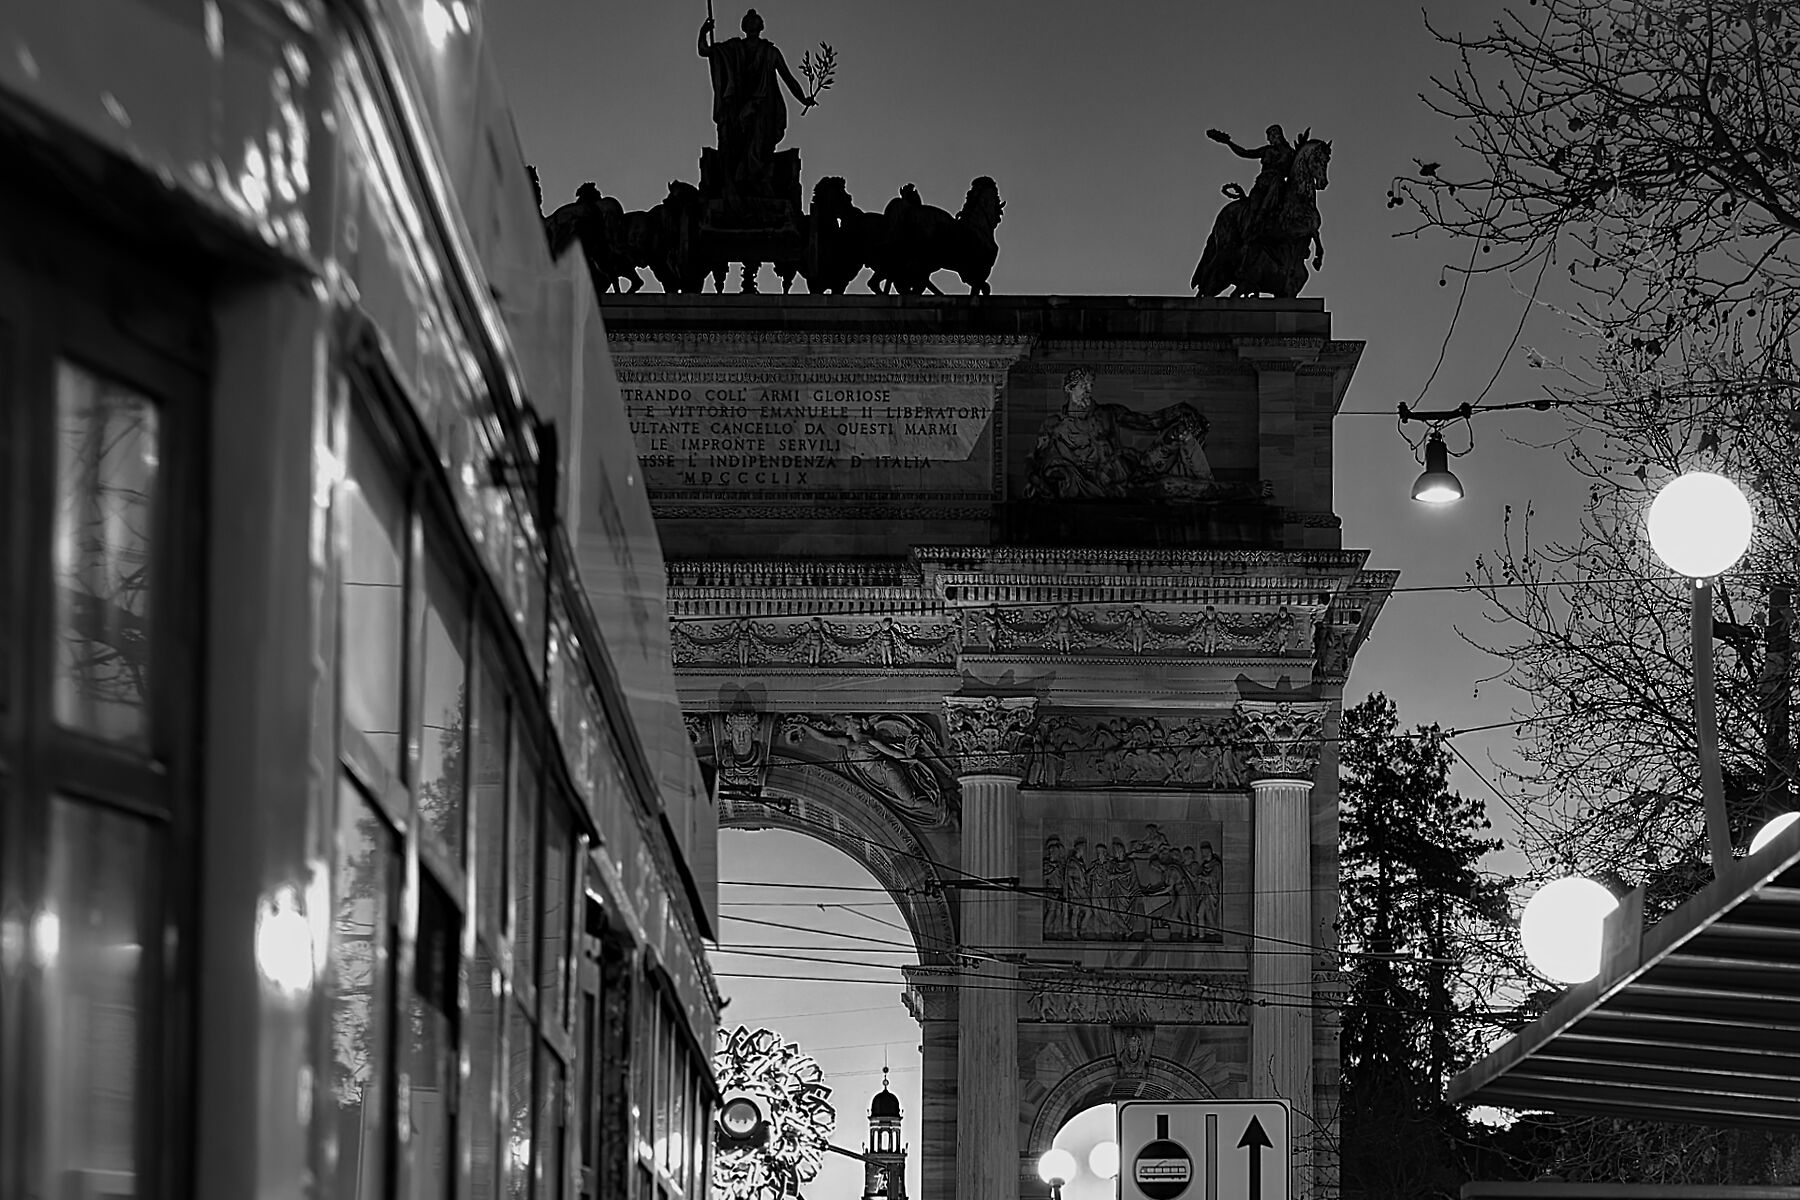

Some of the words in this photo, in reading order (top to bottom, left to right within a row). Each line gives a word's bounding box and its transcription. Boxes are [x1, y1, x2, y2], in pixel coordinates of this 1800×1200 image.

[621, 389, 691, 401] TRANDO
[760, 390, 799, 401] ARMI
[814, 390, 890, 402] GLORIOSE
[647, 406, 655, 417] E
[669, 406, 747, 417] VITTORIO
[760, 406, 848, 418] EMANUELE
[862, 407, 873, 418] II
[887, 406, 986, 419] LIBERATORI
[805, 423, 825, 435] DA
[837, 423, 893, 435] QUESTI
[905, 423, 957, 435] MARMI
[651, 439, 667, 450] LE
[682, 439, 765, 451] IMPRONTE
[779, 439, 840, 451] SERVILI
[710, 455, 836, 468] INDIPENDENZA
[876, 456, 931, 468] ITALIA
